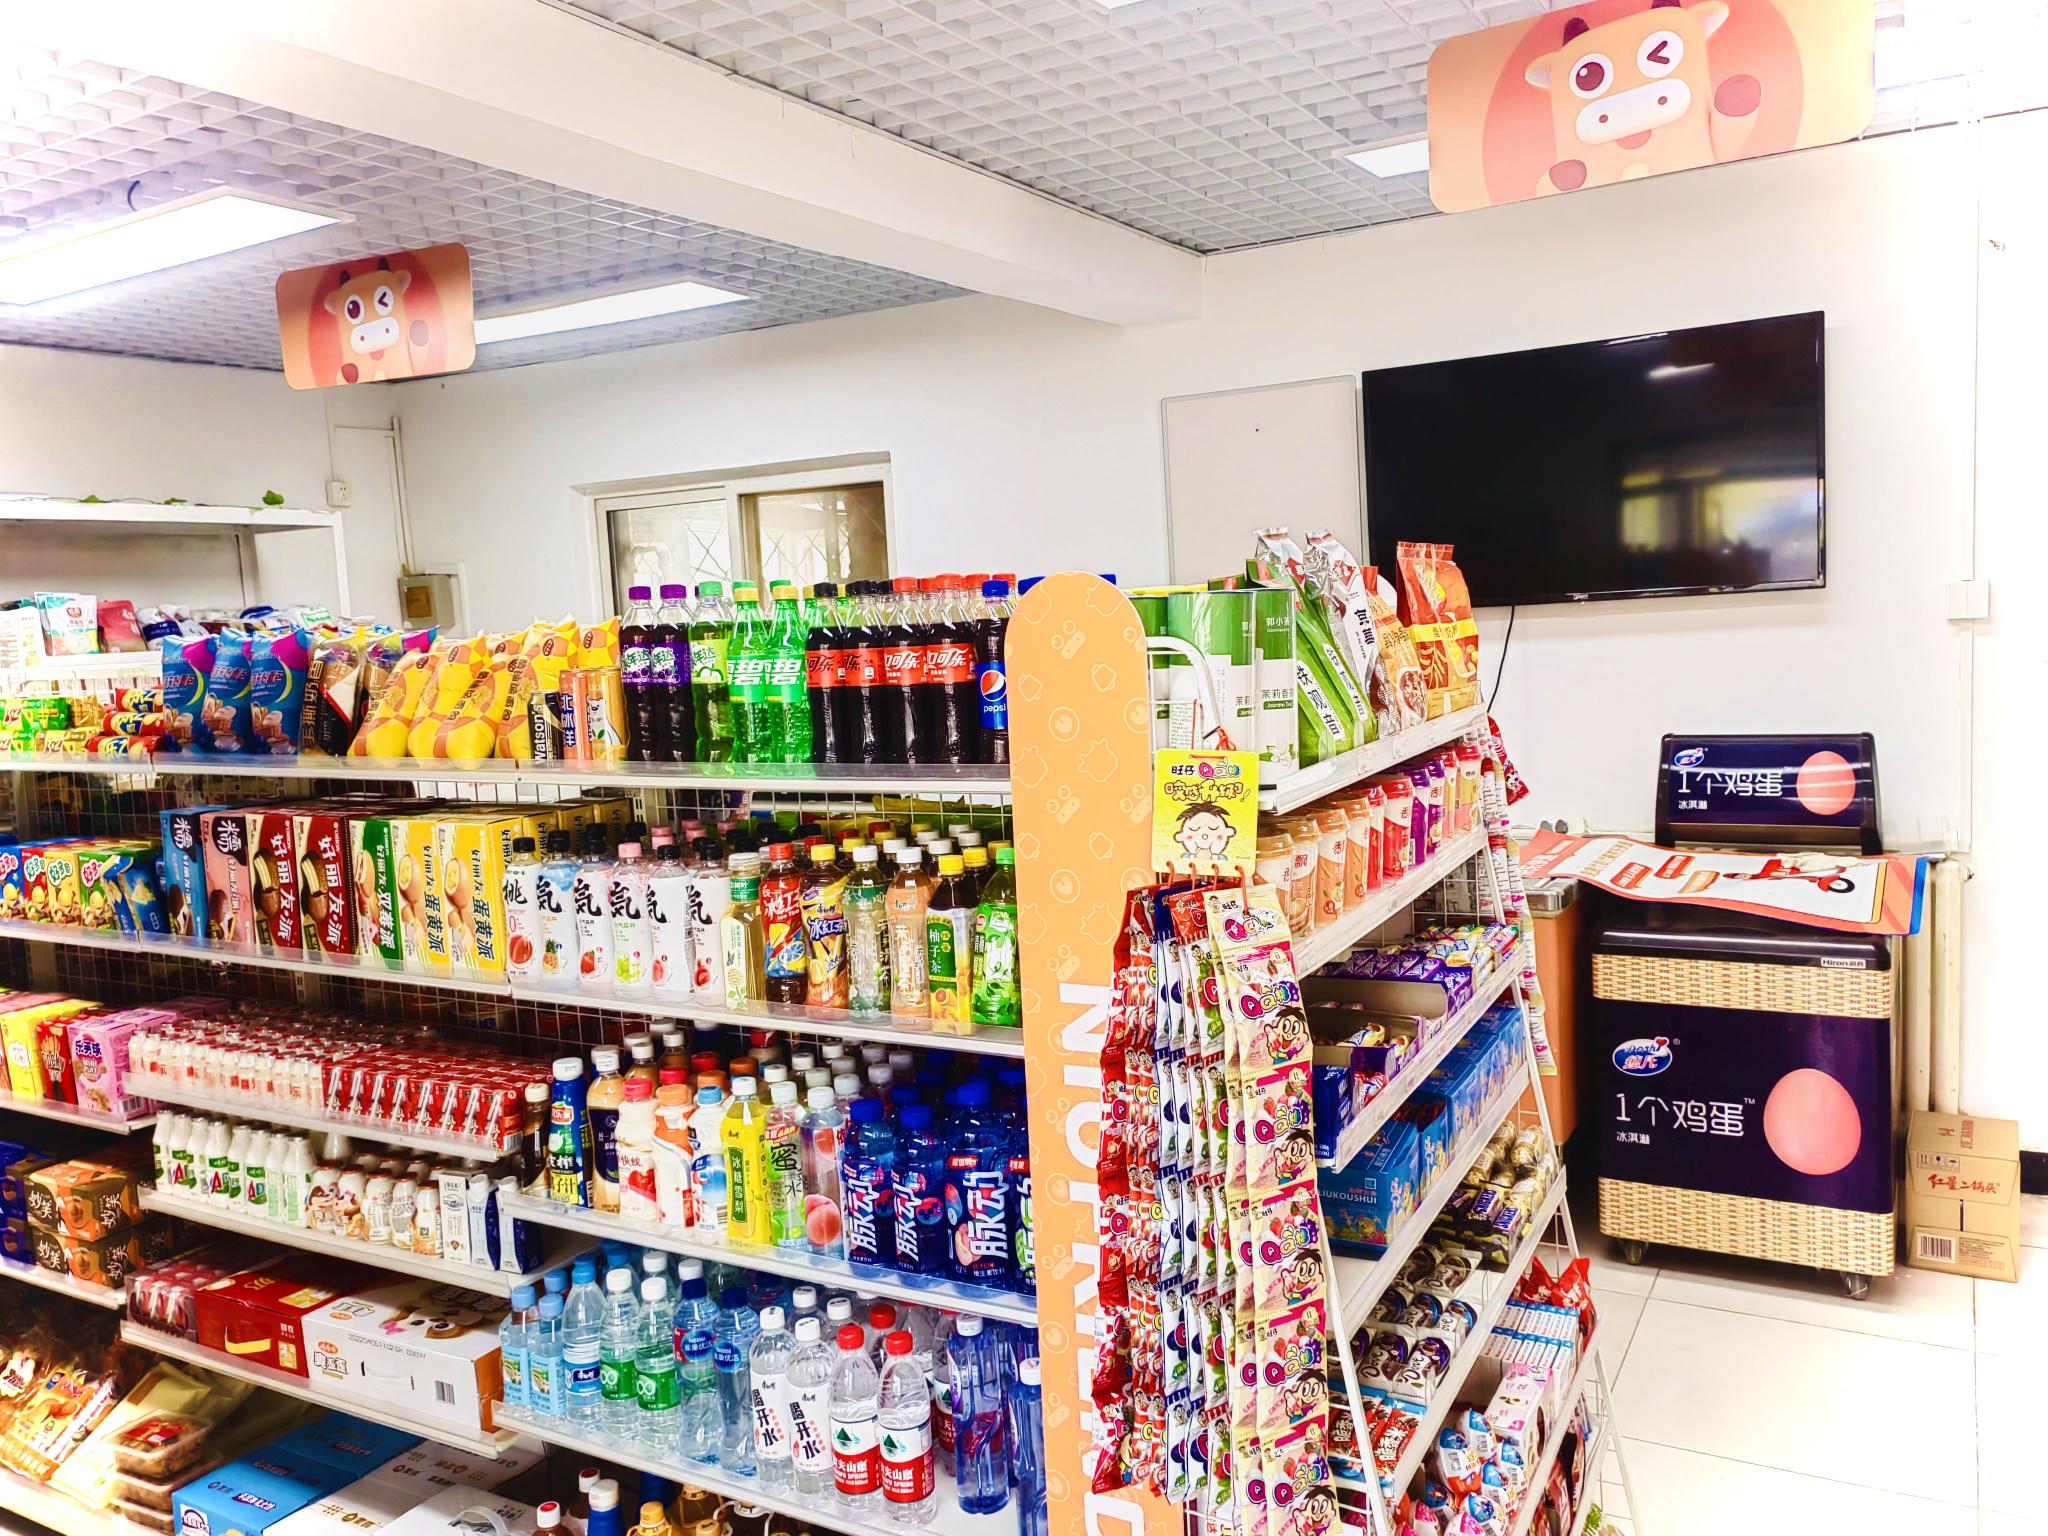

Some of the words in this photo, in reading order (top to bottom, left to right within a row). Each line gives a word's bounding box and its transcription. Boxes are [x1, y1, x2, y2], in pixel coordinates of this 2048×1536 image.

[561, 692, 577, 747] 北冰洋
[1677, 769, 1783, 797] 1个鸡蛋
[807, 917, 850, 941] 冰红茶
[929, 928, 942, 974] 柚子茶
[1615, 1092, 1745, 1137] 1个鸡蛋
[731, 1155, 745, 1214] 冰糖雪梨
[1319, 1190, 1377, 1205] LIUKOUSHUI
[1927, 1173, 1998, 1195] 红星二锅头
[962, 1170, 1010, 1260] 脉动
[1401, 1355, 1425, 1383] Dove
[751, 1388, 780, 1448] 喝开水
[789, 1401, 821, 1460] 喝开水
[1373, 1426, 1409, 1462] 脆香米
